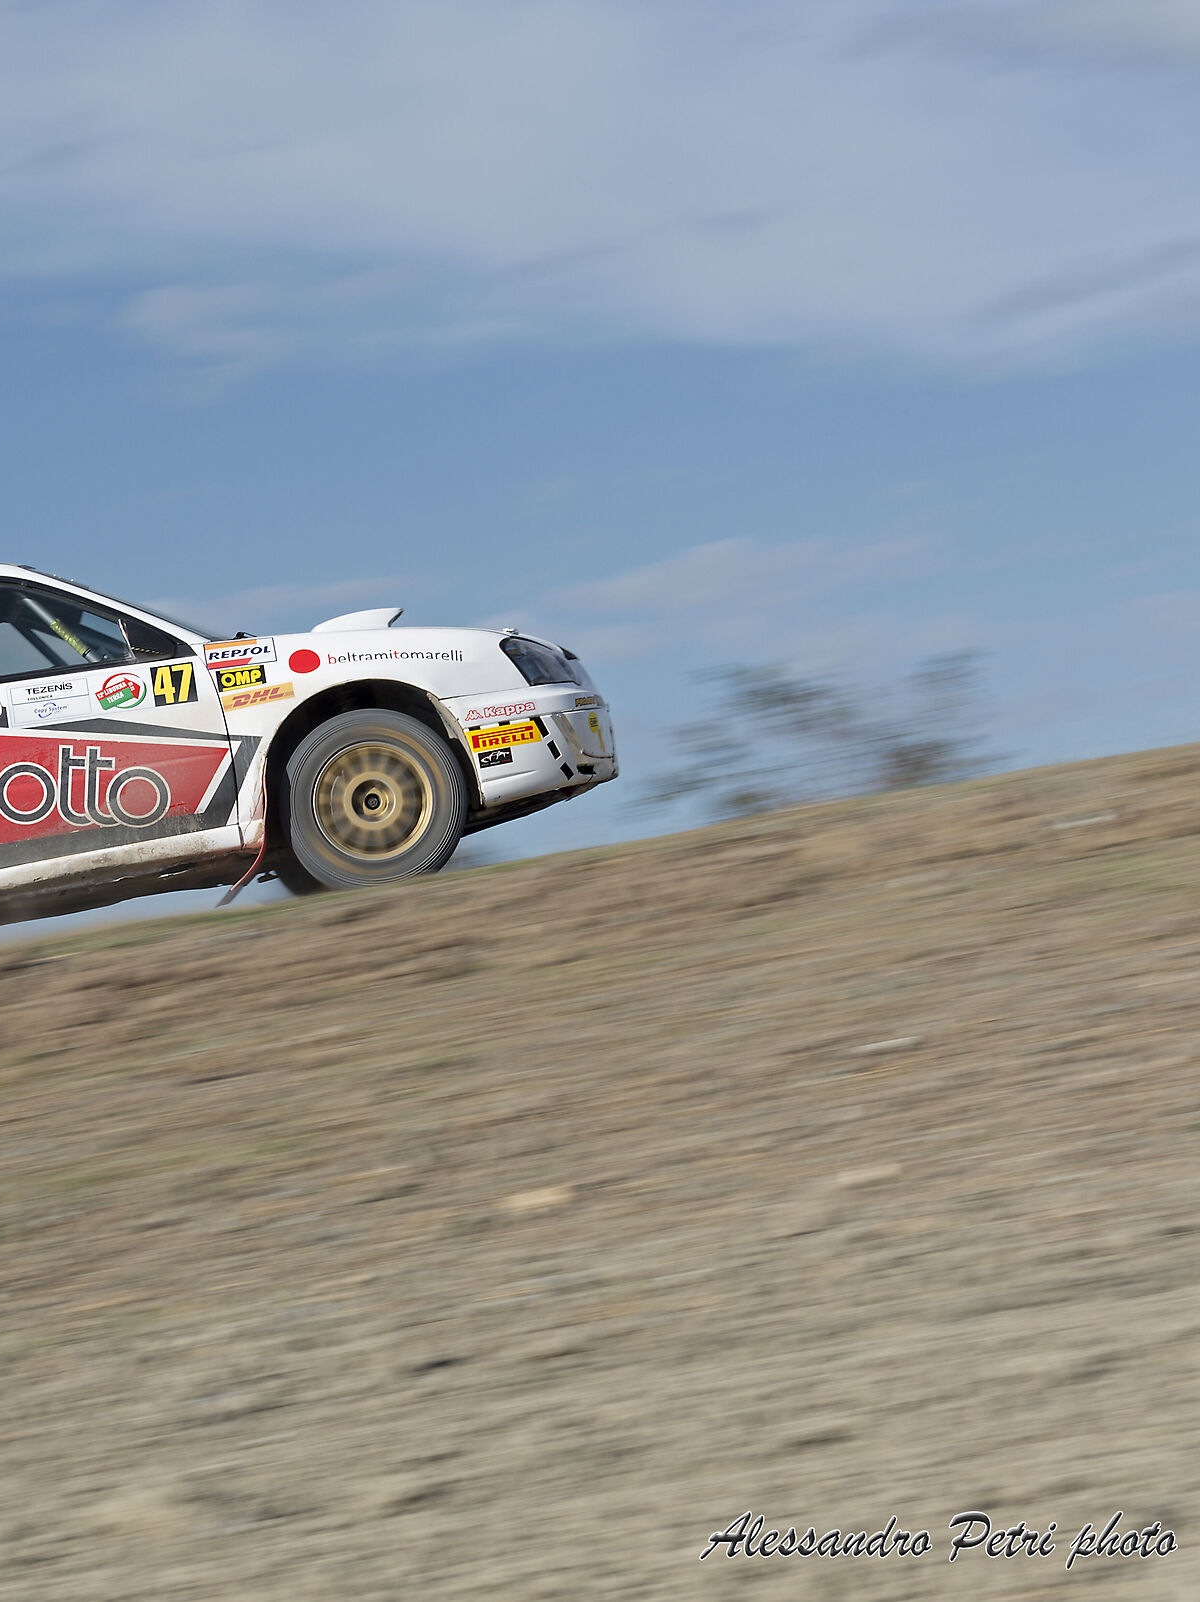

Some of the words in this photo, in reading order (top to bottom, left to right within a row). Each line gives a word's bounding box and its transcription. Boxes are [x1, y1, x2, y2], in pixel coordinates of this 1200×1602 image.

[209, 645, 271, 660] REPSOL
[327, 650, 464, 665] beltramitomarelli
[154, 663, 192, 704] 47
[221, 669, 261, 688] OMP
[233, 687, 284, 708] DHL
[484, 702, 535, 718] Kappa
[472, 725, 534, 749] PIRELLI
